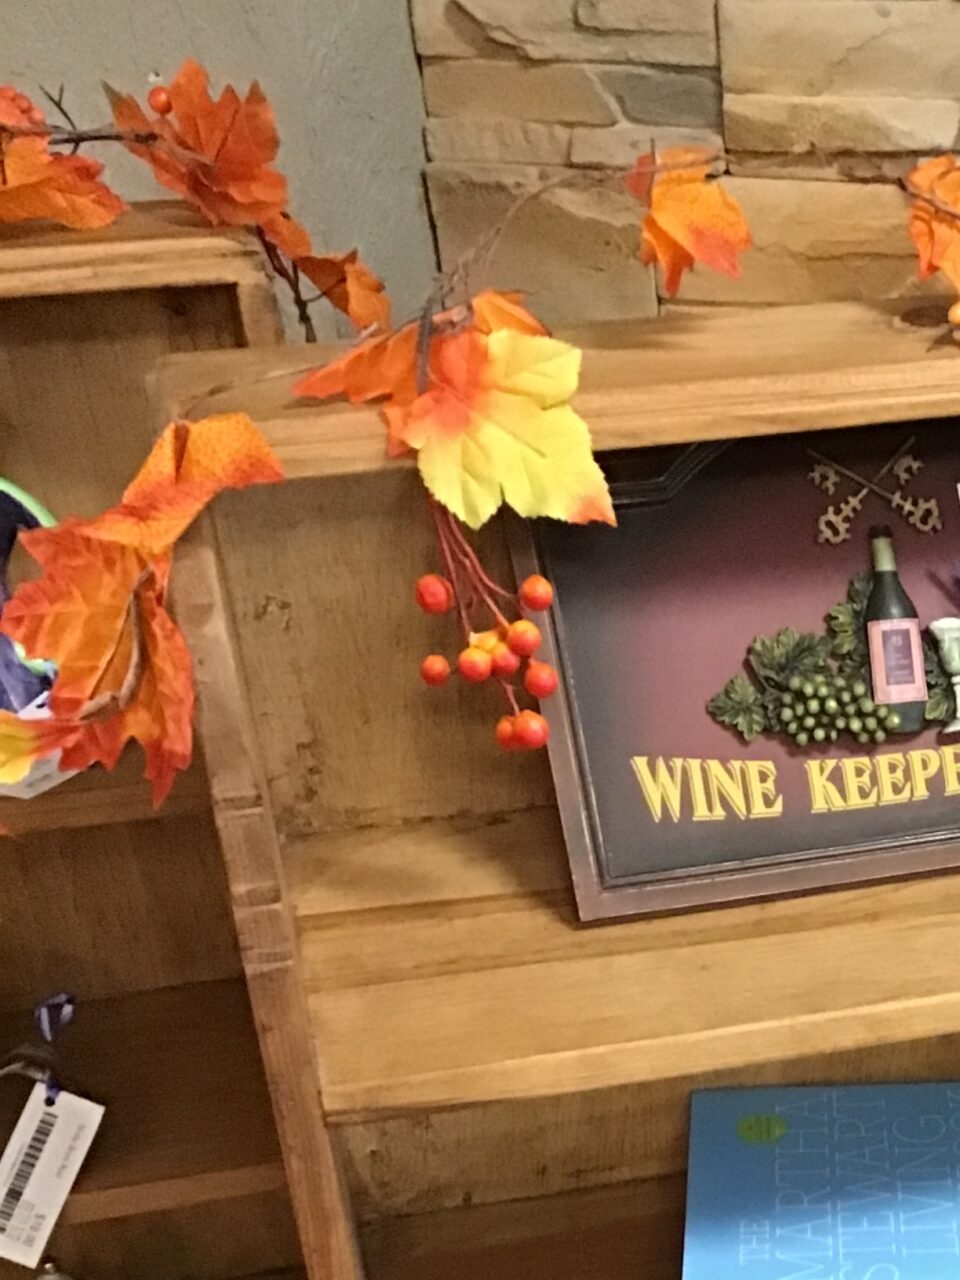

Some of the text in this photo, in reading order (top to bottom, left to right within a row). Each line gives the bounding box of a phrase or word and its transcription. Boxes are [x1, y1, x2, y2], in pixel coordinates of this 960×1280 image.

[630, 754, 784, 823] WINE
[892, 1113, 960, 1258] LIVING
[739, 1219, 770, 1266] THE
